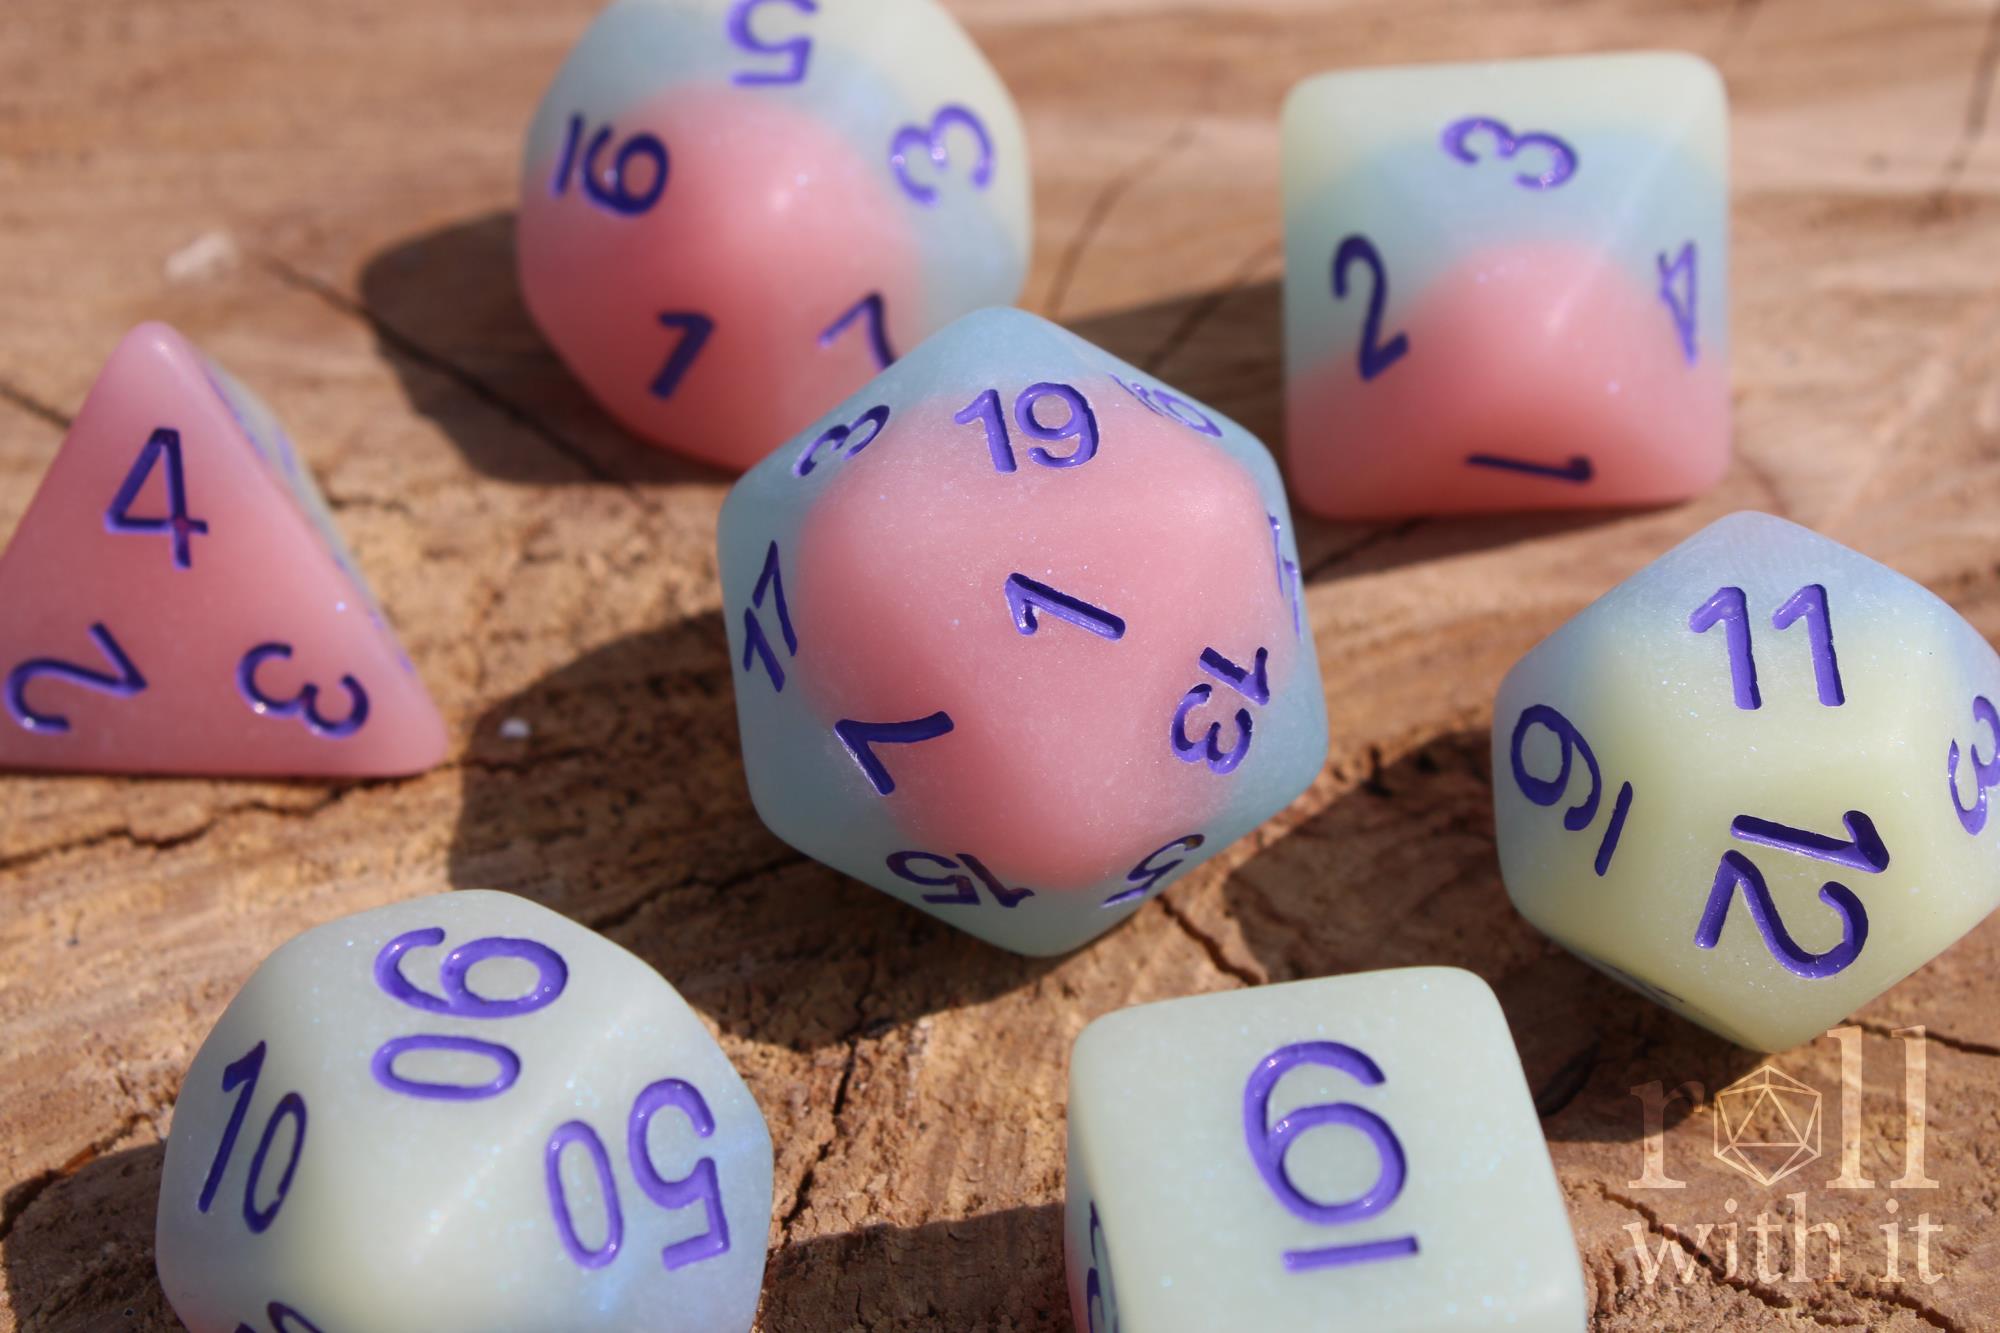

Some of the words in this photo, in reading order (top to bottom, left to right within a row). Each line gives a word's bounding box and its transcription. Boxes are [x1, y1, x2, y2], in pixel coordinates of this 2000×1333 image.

[725, 0, 816, 88] 5
[889, 104, 995, 206] 3
[1439, 116, 1581, 191] 3
[1331, 234, 1408, 381] 2
[791, 404, 890, 478] 3
[955, 381, 1100, 474] 19
[105, 427, 208, 569] 4
[742, 538, 798, 693] 17
[1004, 572, 1126, 641] 1
[1690, 583, 1845, 710] 11
[4, 623, 147, 735] 2
[237, 643, 369, 740] 3
[1170, 646, 1270, 776] 13
[832, 711, 954, 797] 7
[886, 851, 1035, 908] 15
[1102, 834, 1204, 907] 5
[1694, 811, 1890, 979] 12
[197, 1040, 308, 1234] 10
[545, 1077, 732, 1272] 50
